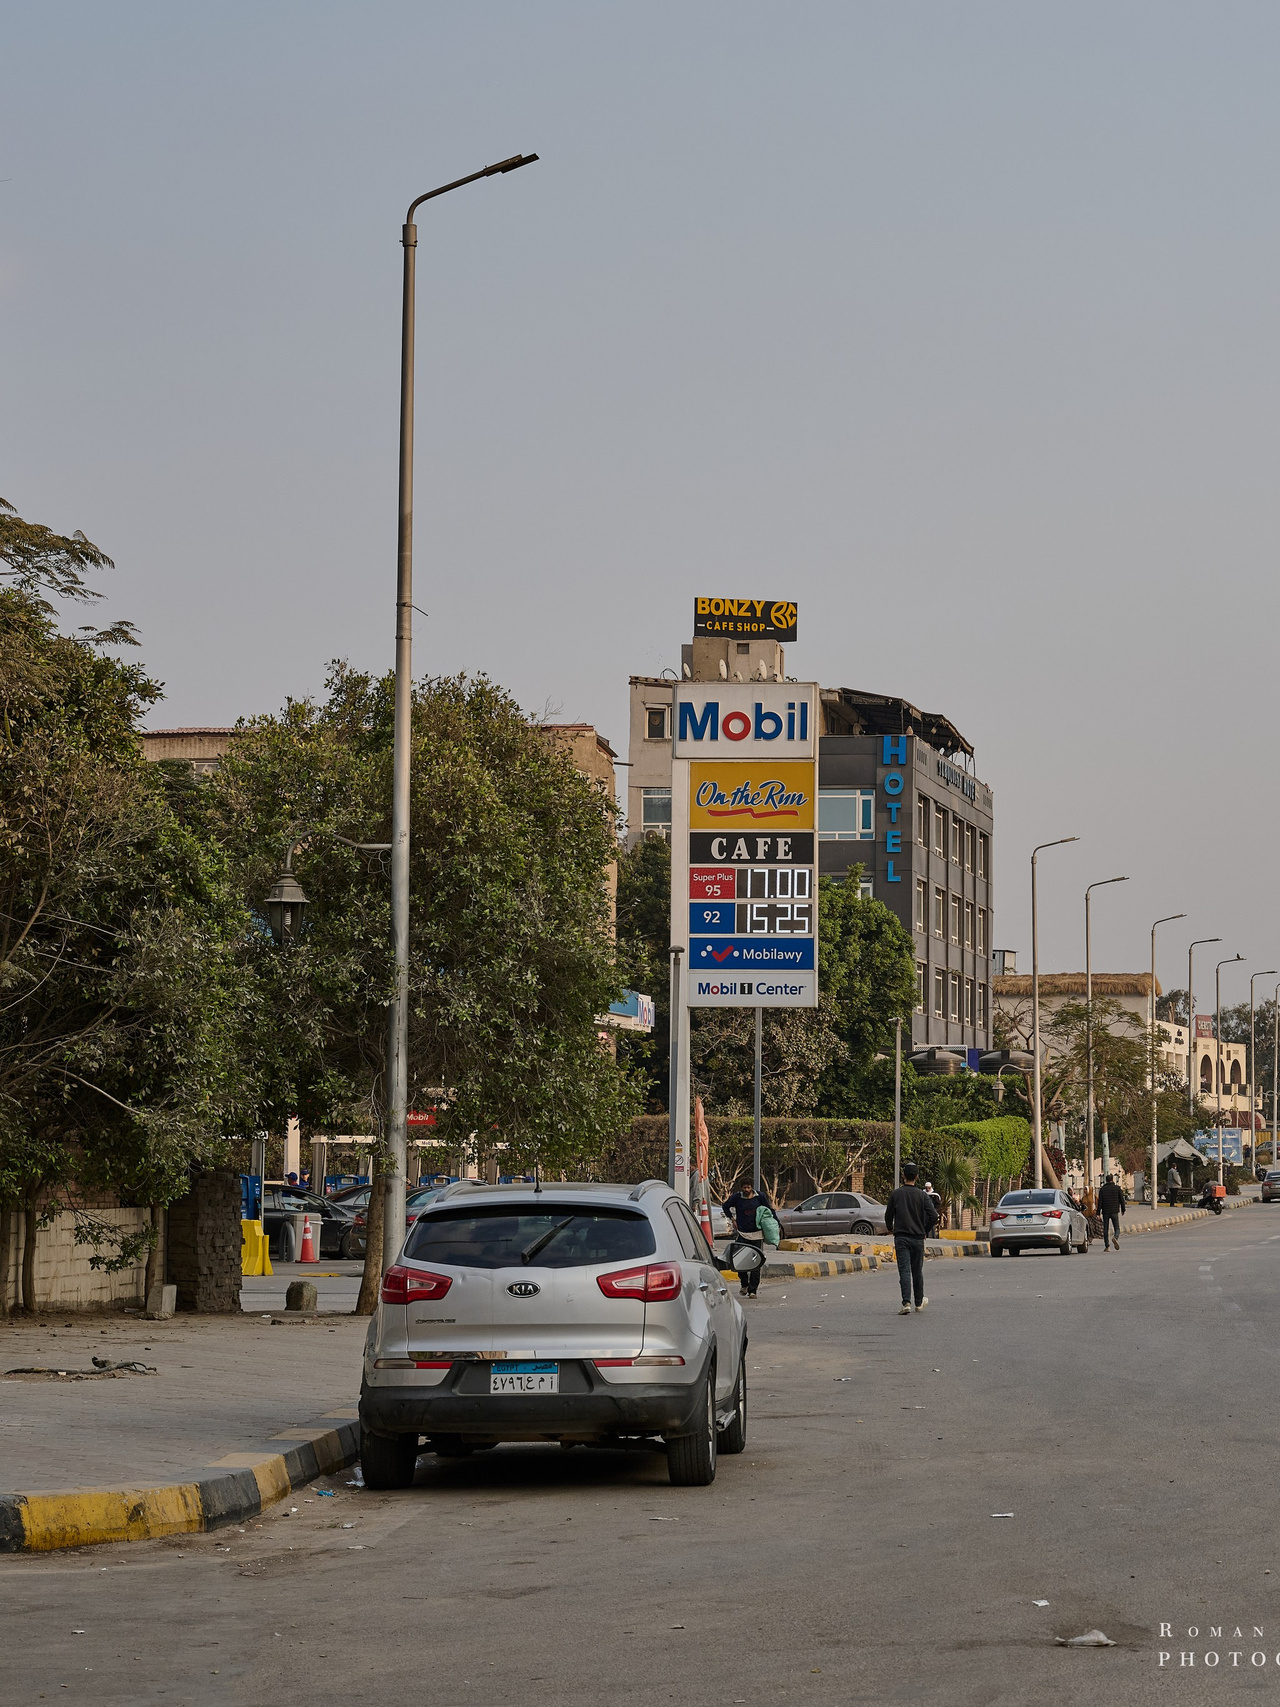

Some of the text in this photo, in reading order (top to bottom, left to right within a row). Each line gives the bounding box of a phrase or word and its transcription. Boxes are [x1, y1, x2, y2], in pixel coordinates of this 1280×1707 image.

[697, 597, 765, 617] BONZY
[706, 621, 765, 632] CAFE SHOP
[679, 702, 808, 741] Mobil
[695, 780, 808, 810] On the Run
[883, 735, 906, 882] HOTEL
[711, 837, 792, 860] CAFE
[693, 873, 733, 882] Super Plus
[747, 869, 809, 898] 17.00
[705, 885, 721, 896] 95
[703, 911, 720, 923] 92
[747, 904, 809, 933] 15.25
[743, 948, 802, 962] Mobilawy
[698, 982, 736, 995] Mobil
[756, 982, 804, 995] Center
[406, 1113, 429, 1121] Mobil
[512, 1284, 534, 1294] KIA
[532, 1363, 553, 1371] مصر
